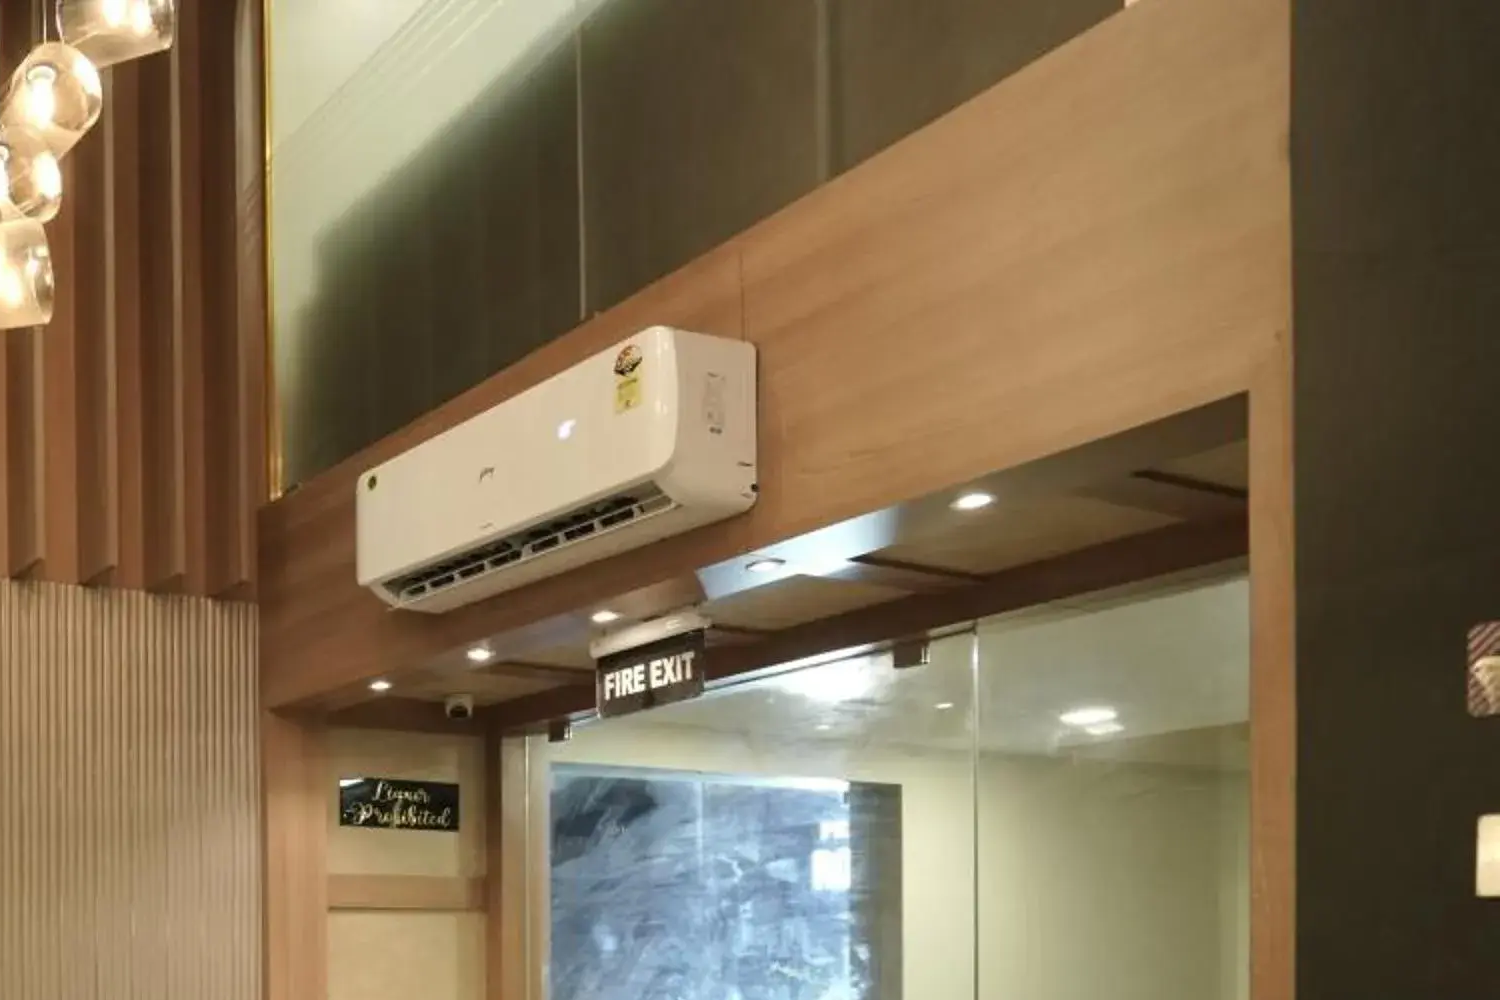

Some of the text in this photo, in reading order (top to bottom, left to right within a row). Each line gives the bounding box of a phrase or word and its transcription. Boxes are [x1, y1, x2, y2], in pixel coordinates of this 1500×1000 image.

[603, 650, 696, 701] FIRE EXIT
[344, 799, 451, 828] Prohibited
